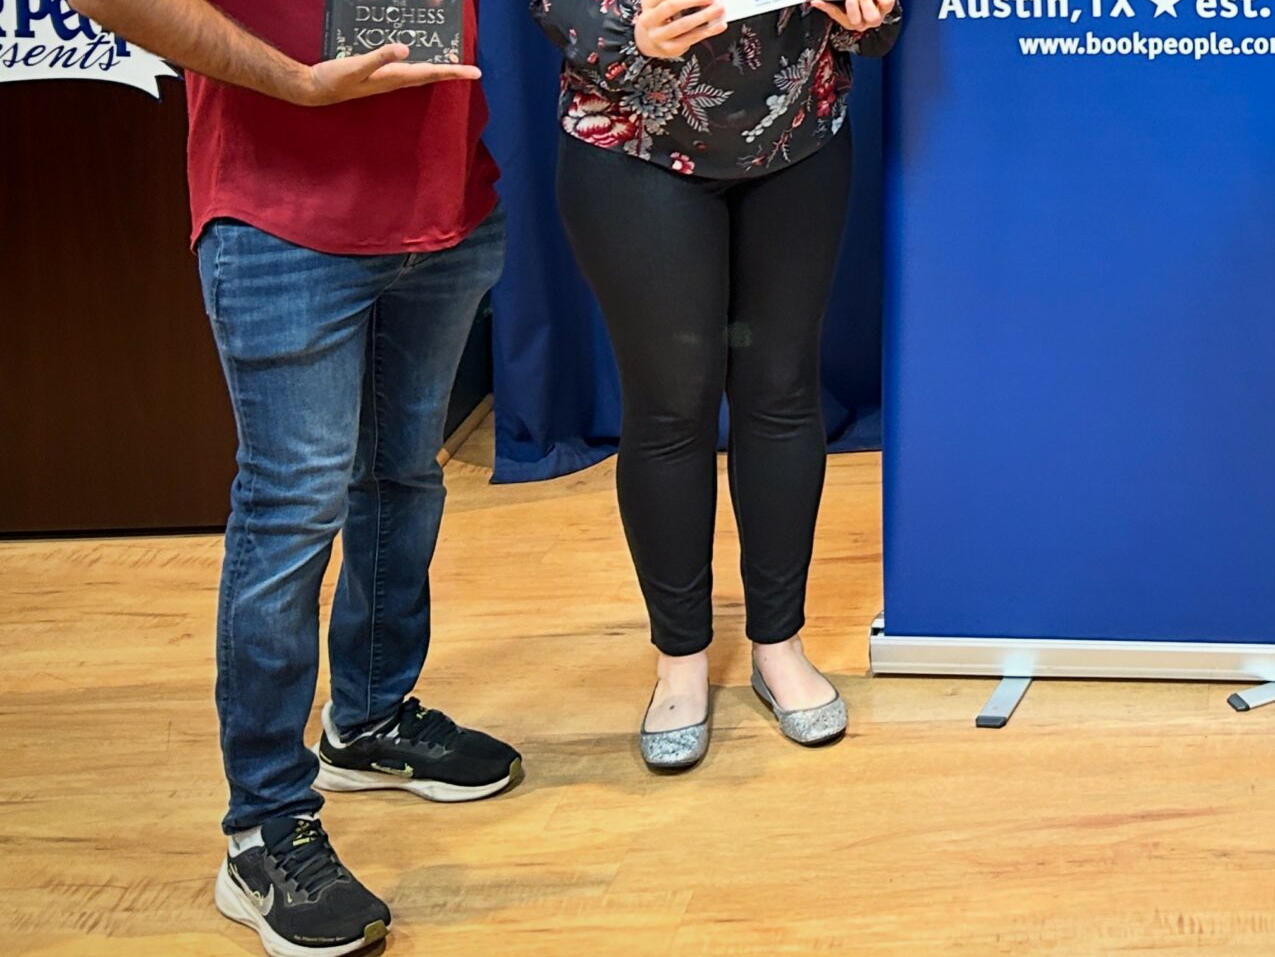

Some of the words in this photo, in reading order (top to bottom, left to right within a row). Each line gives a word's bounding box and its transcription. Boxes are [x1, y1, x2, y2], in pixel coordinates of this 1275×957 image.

[355, 5, 445, 24] DUCHESS
[353, 27, 445, 50] KOKORA
[0, 32, 121, 72] sents
